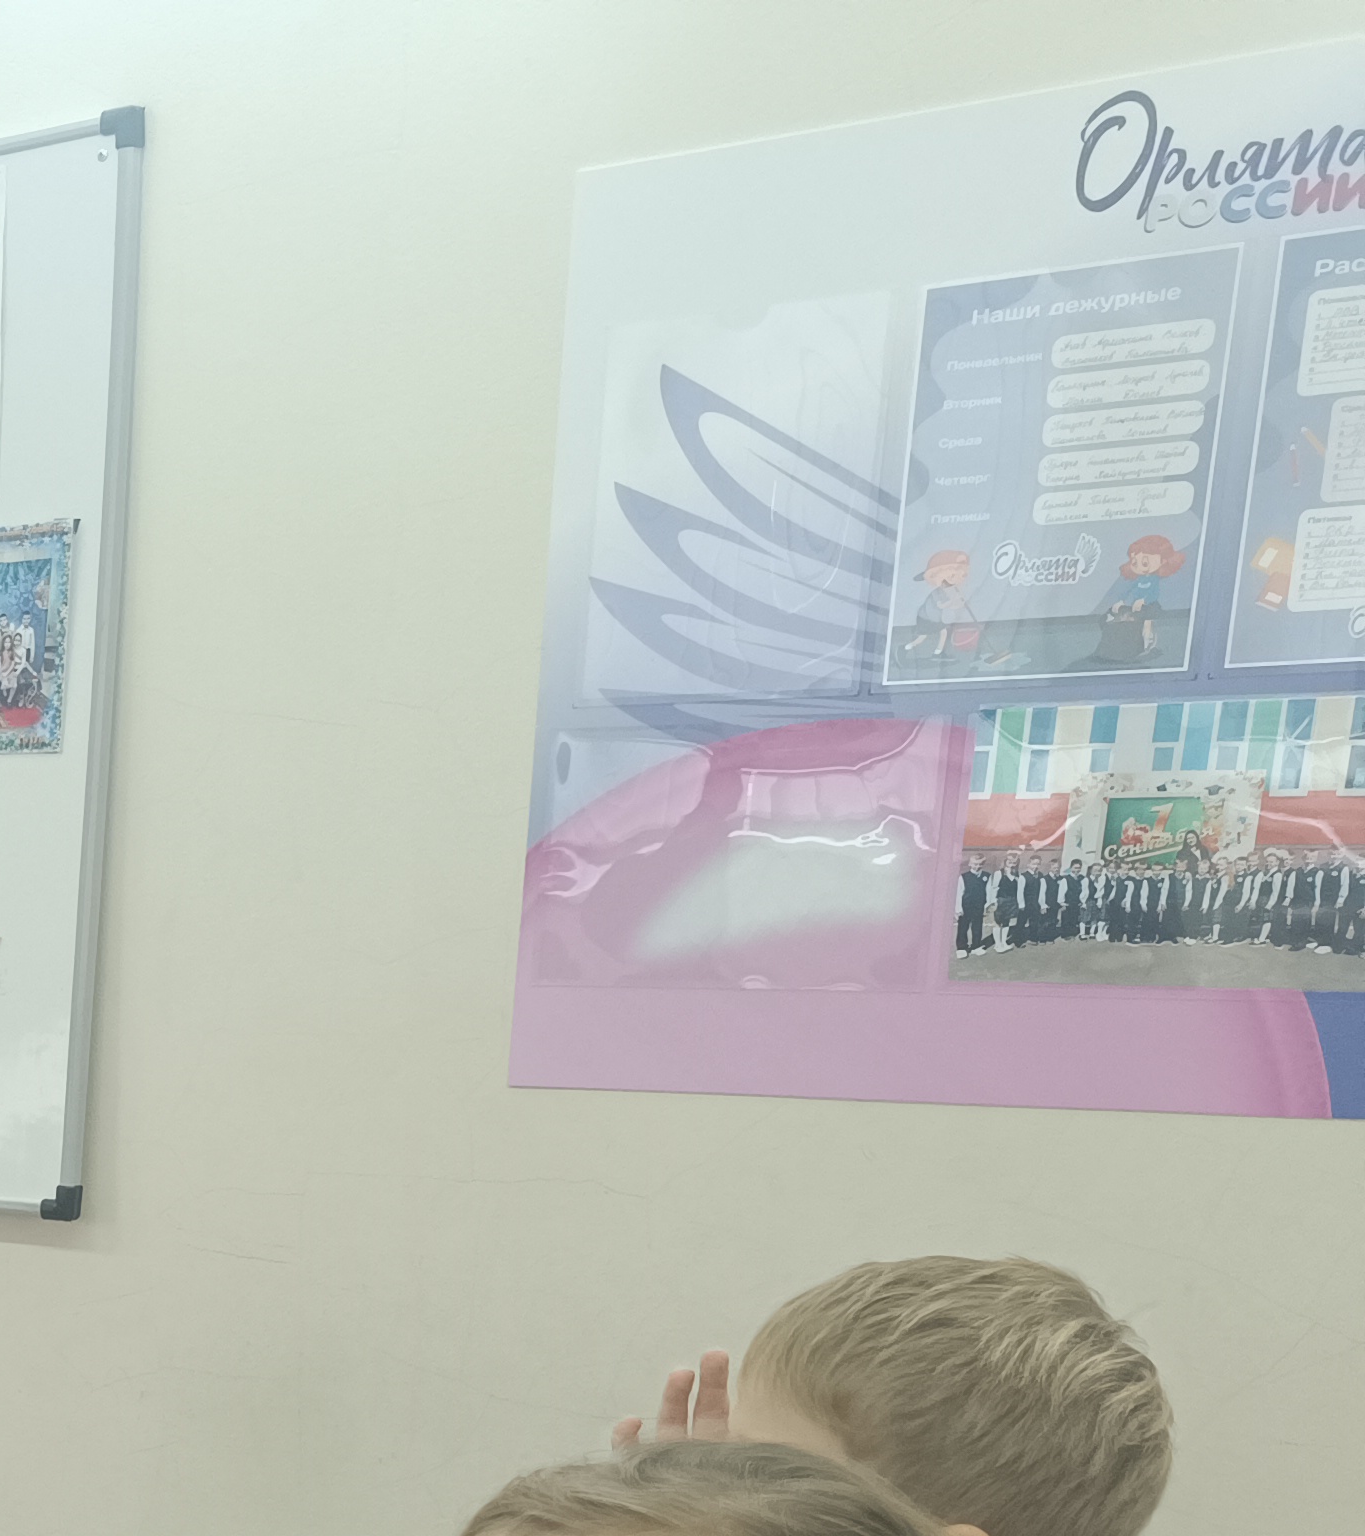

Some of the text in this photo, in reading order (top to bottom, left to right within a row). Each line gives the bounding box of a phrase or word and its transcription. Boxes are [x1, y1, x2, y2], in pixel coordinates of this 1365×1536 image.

[1076, 90, 1365, 220] Орлята
[971, 286, 1182, 326] Наши дежурные
[945, 351, 1043, 372] Понедельник
[942, 396, 1003, 411] Вторник
[937, 435, 983, 449] Среда
[934, 472, 991, 488] Четверг
[930, 511, 991, 525] Пятница
[1150, 802, 1175, 833] 1
[1103, 826, 1215, 861] Сентябя
